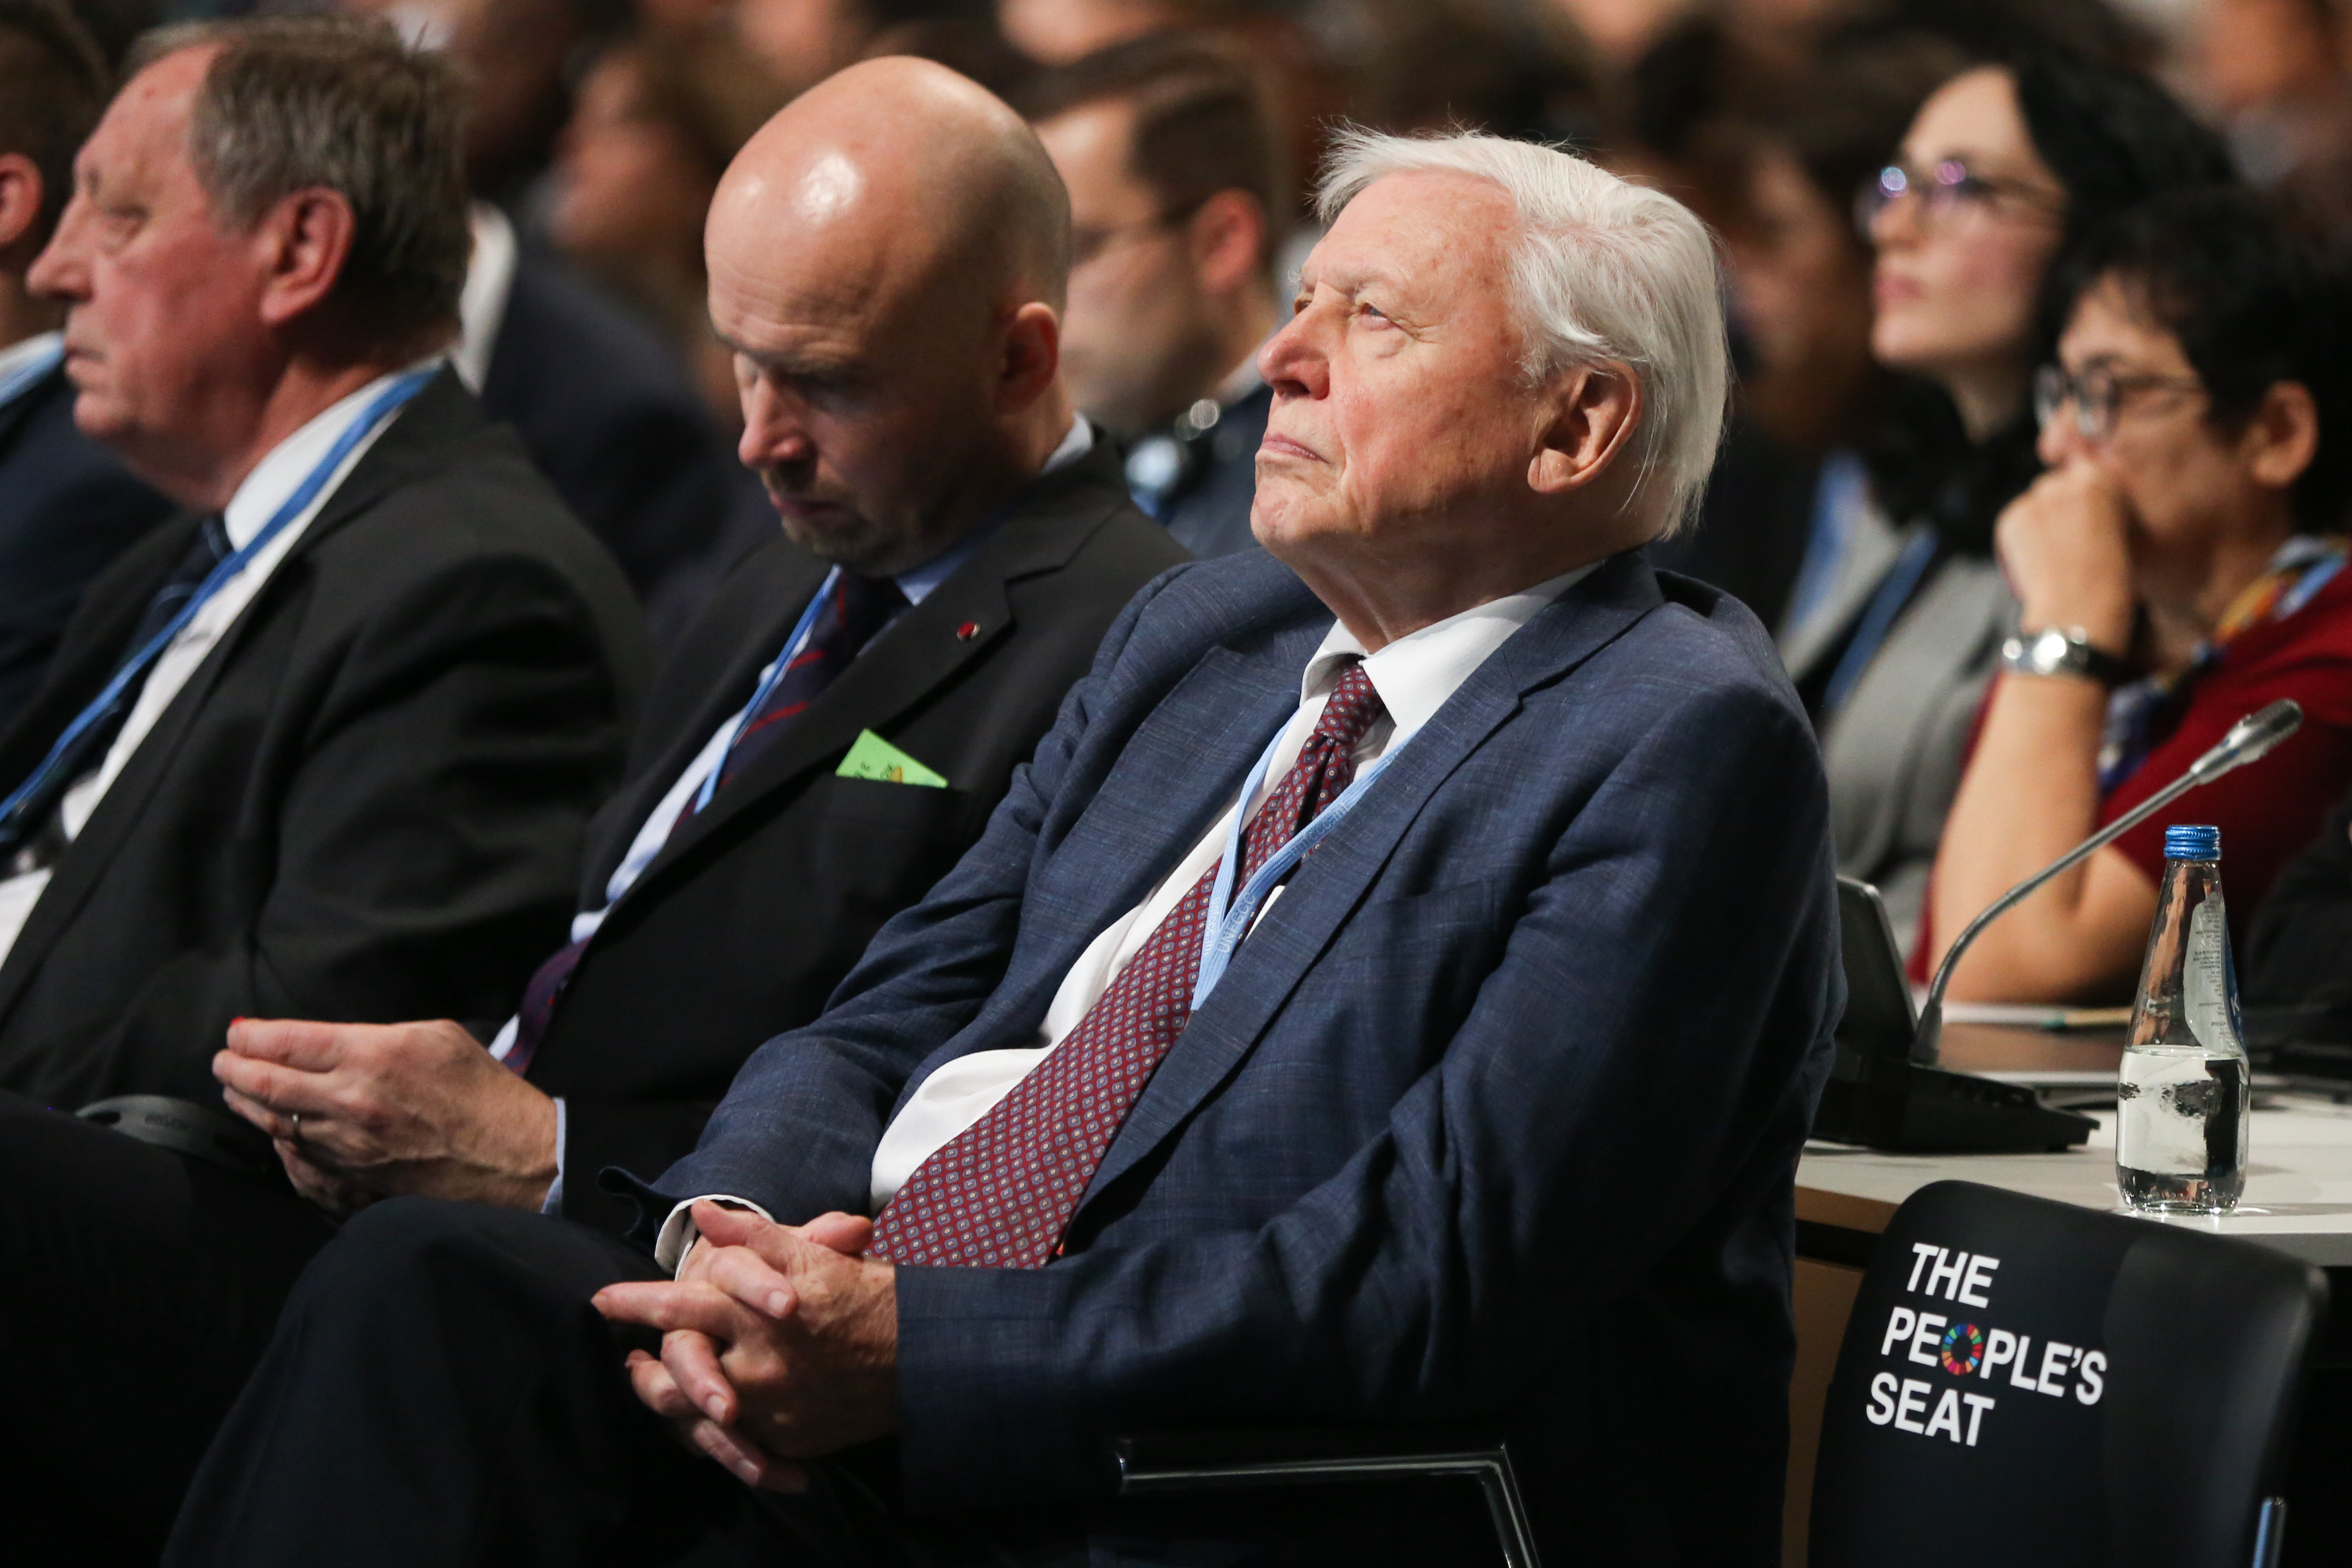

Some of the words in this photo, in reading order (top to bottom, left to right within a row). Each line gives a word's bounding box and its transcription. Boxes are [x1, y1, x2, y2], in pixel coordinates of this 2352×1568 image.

[1216, 892, 1256, 953] UNFCCC
[1907, 1242, 2000, 1309] THE
[1881, 1306, 2107, 1405] PEOPLE'S
[1866, 1372, 1995, 1447] SEAT
